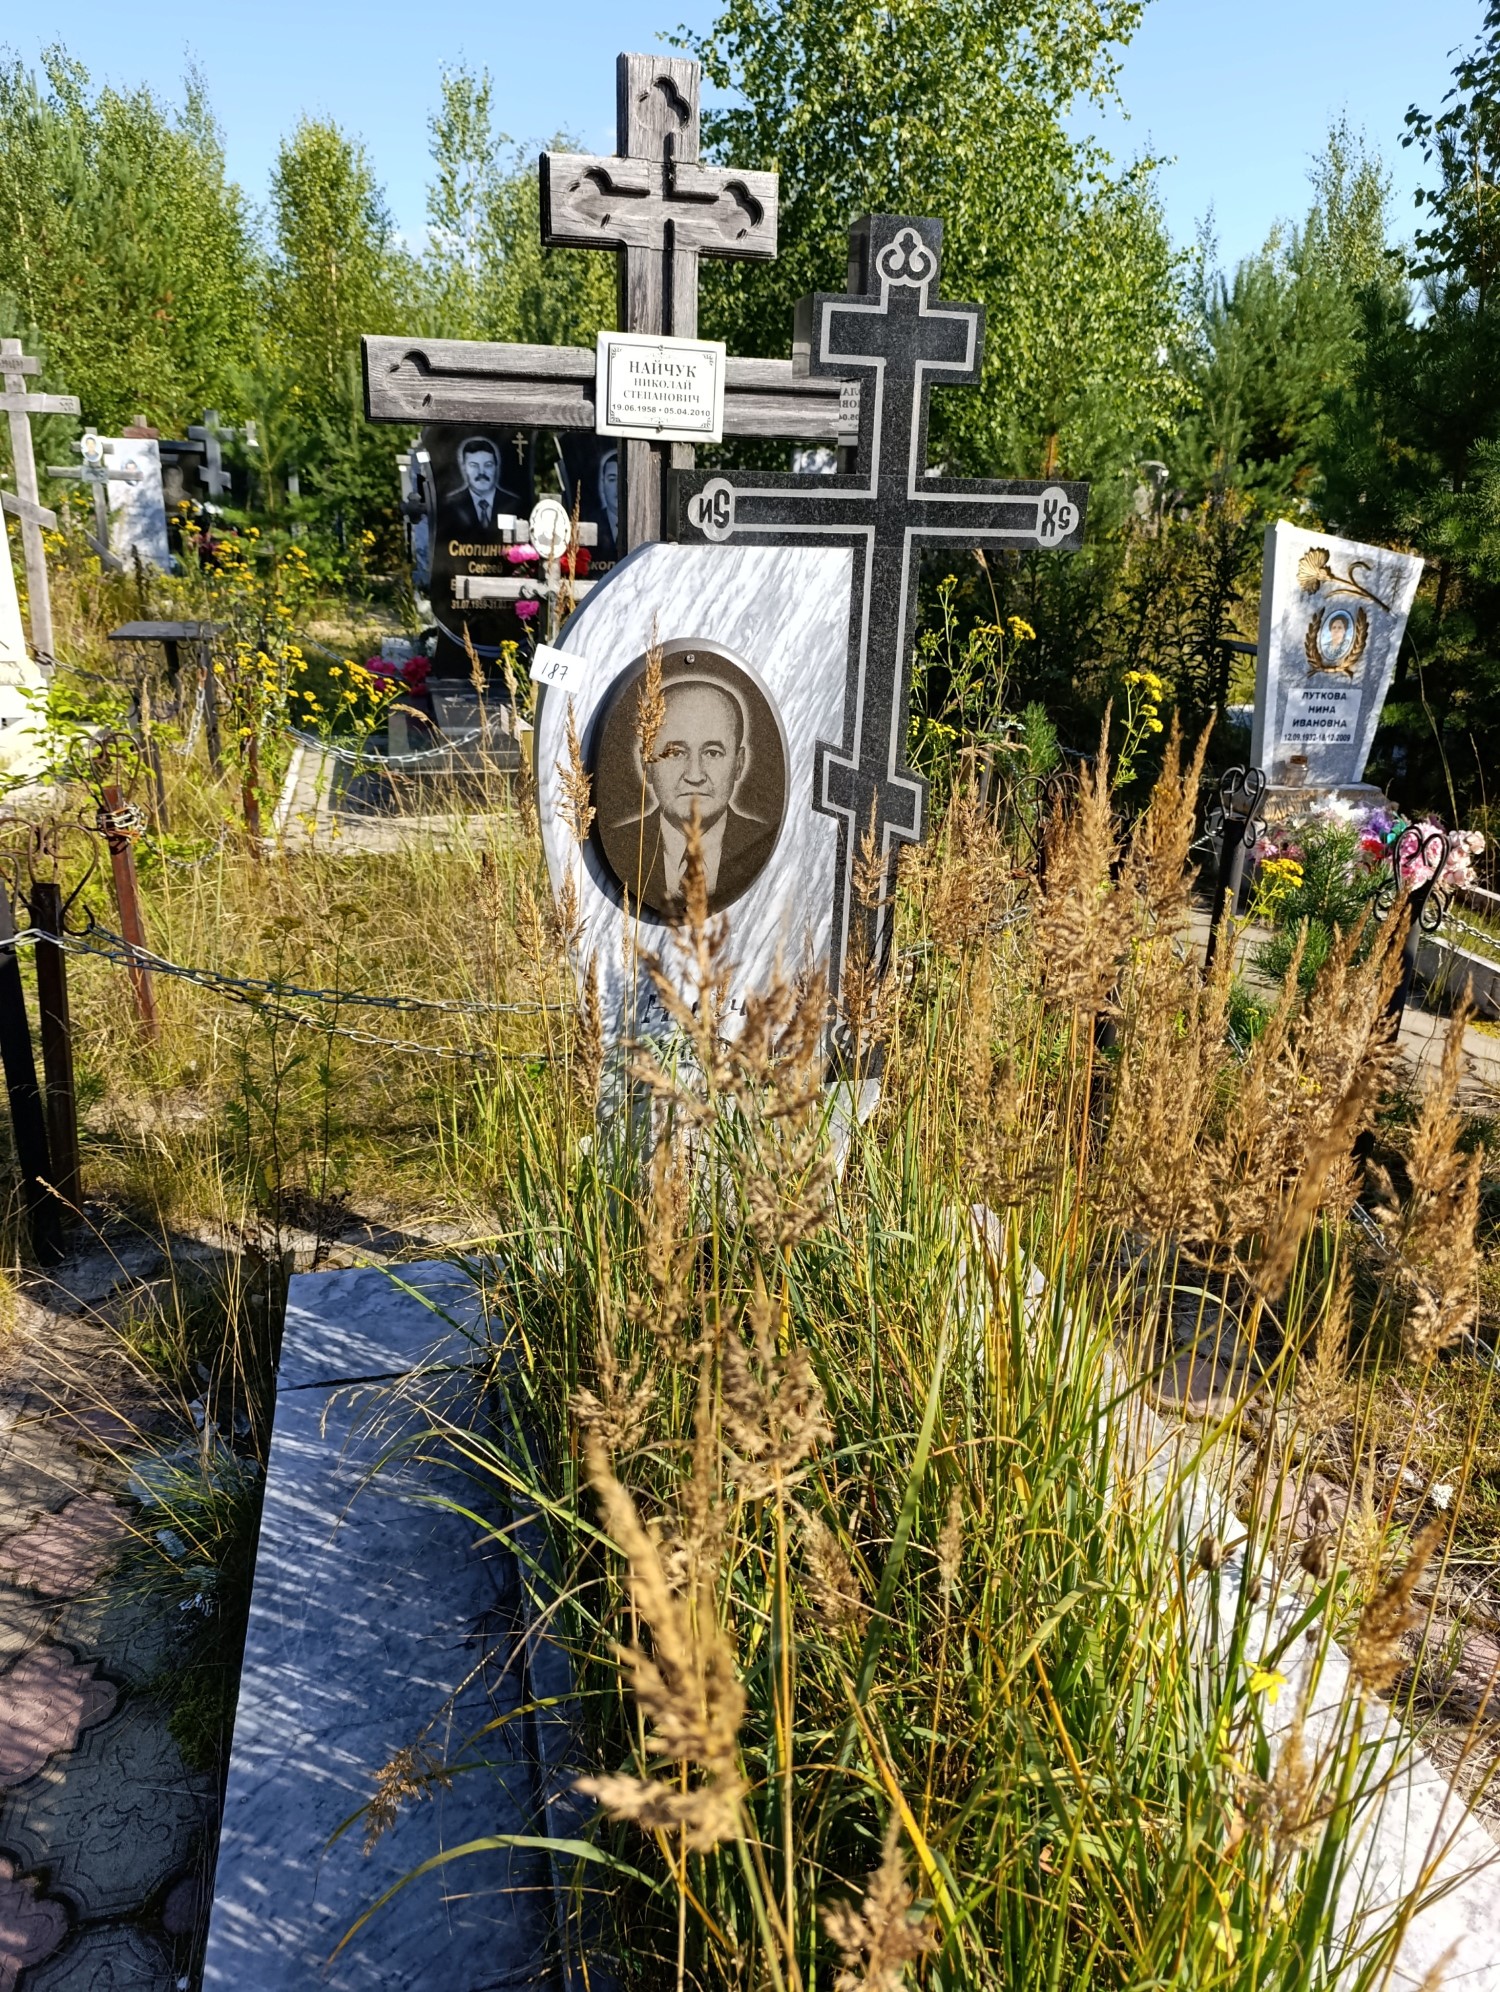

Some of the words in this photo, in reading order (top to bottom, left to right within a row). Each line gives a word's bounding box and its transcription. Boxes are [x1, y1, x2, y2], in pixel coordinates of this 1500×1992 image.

[629, 359, 697, 378] НАЙЧУК
[634, 378, 691, 390] НИКОЛАЙ
[623, 390, 699, 403] СТЕПАНОВИЧ
[612, 404, 657, 413] 19.06.1958
[664, 407, 710, 416] 05.04.2010
[541, 659, 569, 681] 187
[1308, 705, 1336, 714] НИНА
[1292, 719, 1347, 728] ИВАНОВНА
